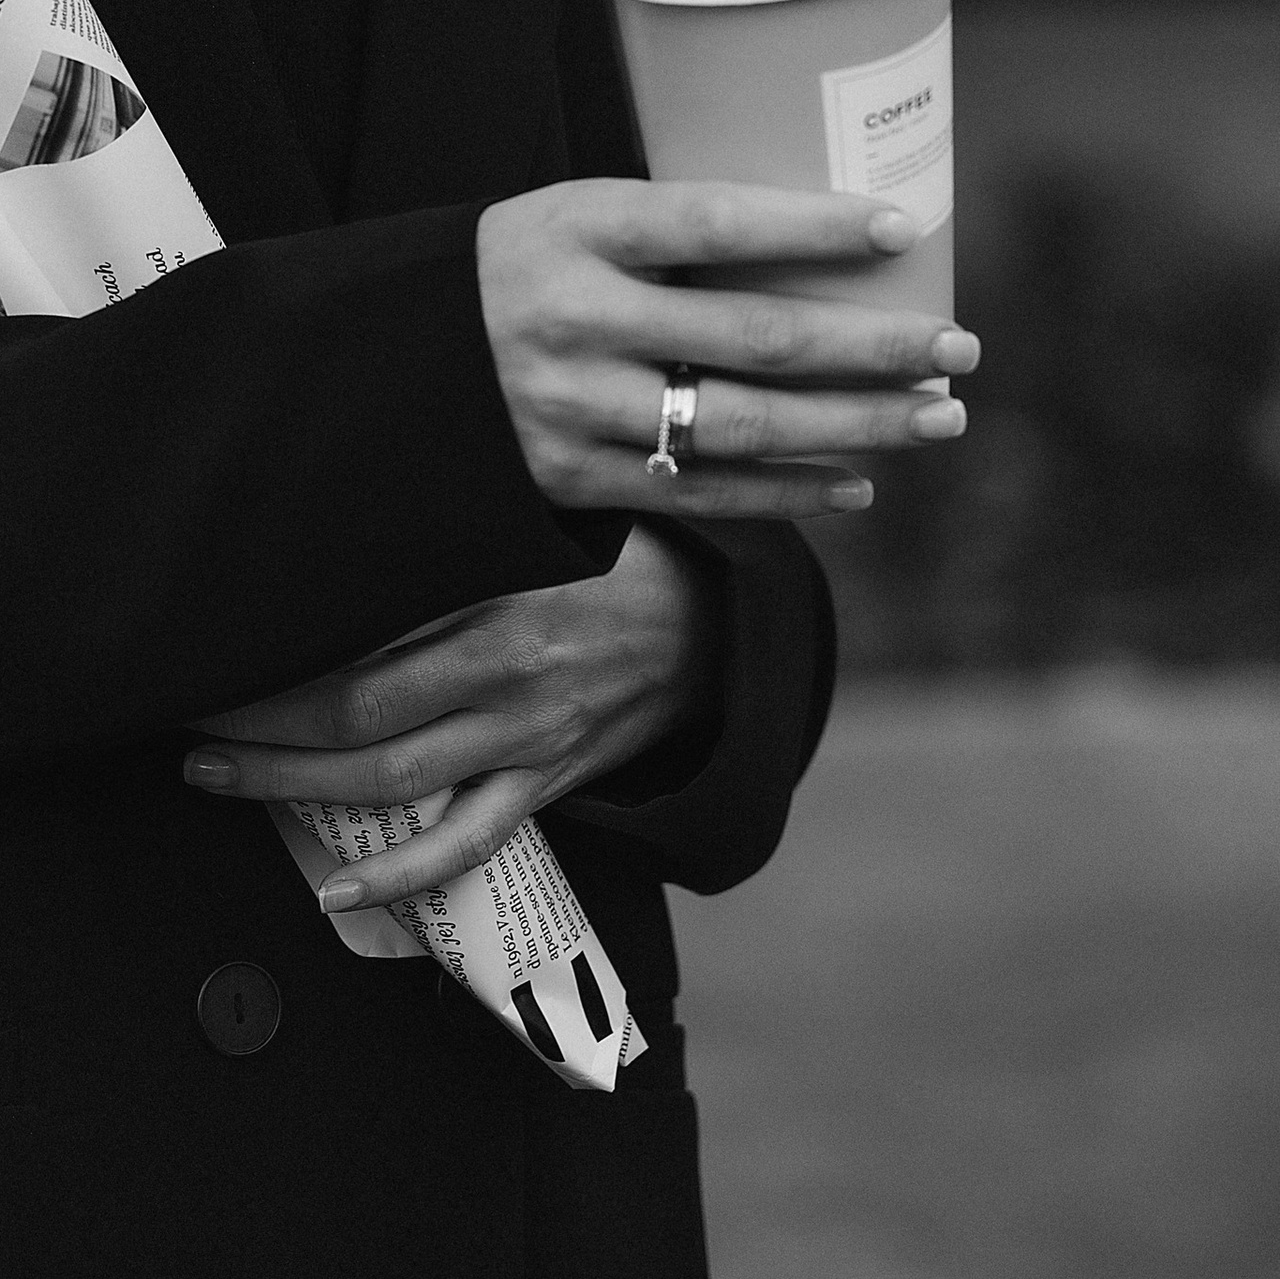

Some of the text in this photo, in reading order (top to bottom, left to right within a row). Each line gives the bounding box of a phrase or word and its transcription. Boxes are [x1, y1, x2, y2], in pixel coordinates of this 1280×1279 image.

[863, 85, 934, 130] COFFEE
[521, 822, 543, 856] pour
[483, 866, 496, 884] se
[511, 852, 527, 882] une
[426, 885, 447, 916] sty
[530, 863, 563, 931] magazine
[509, 890, 532, 937] conflit
[523, 881, 559, 961] apeine-soit
[570, 898, 588, 933] dans
[429, 922, 461, 945] jej
[560, 931, 572, 953] Le
[526, 938, 541, 969] d'un
